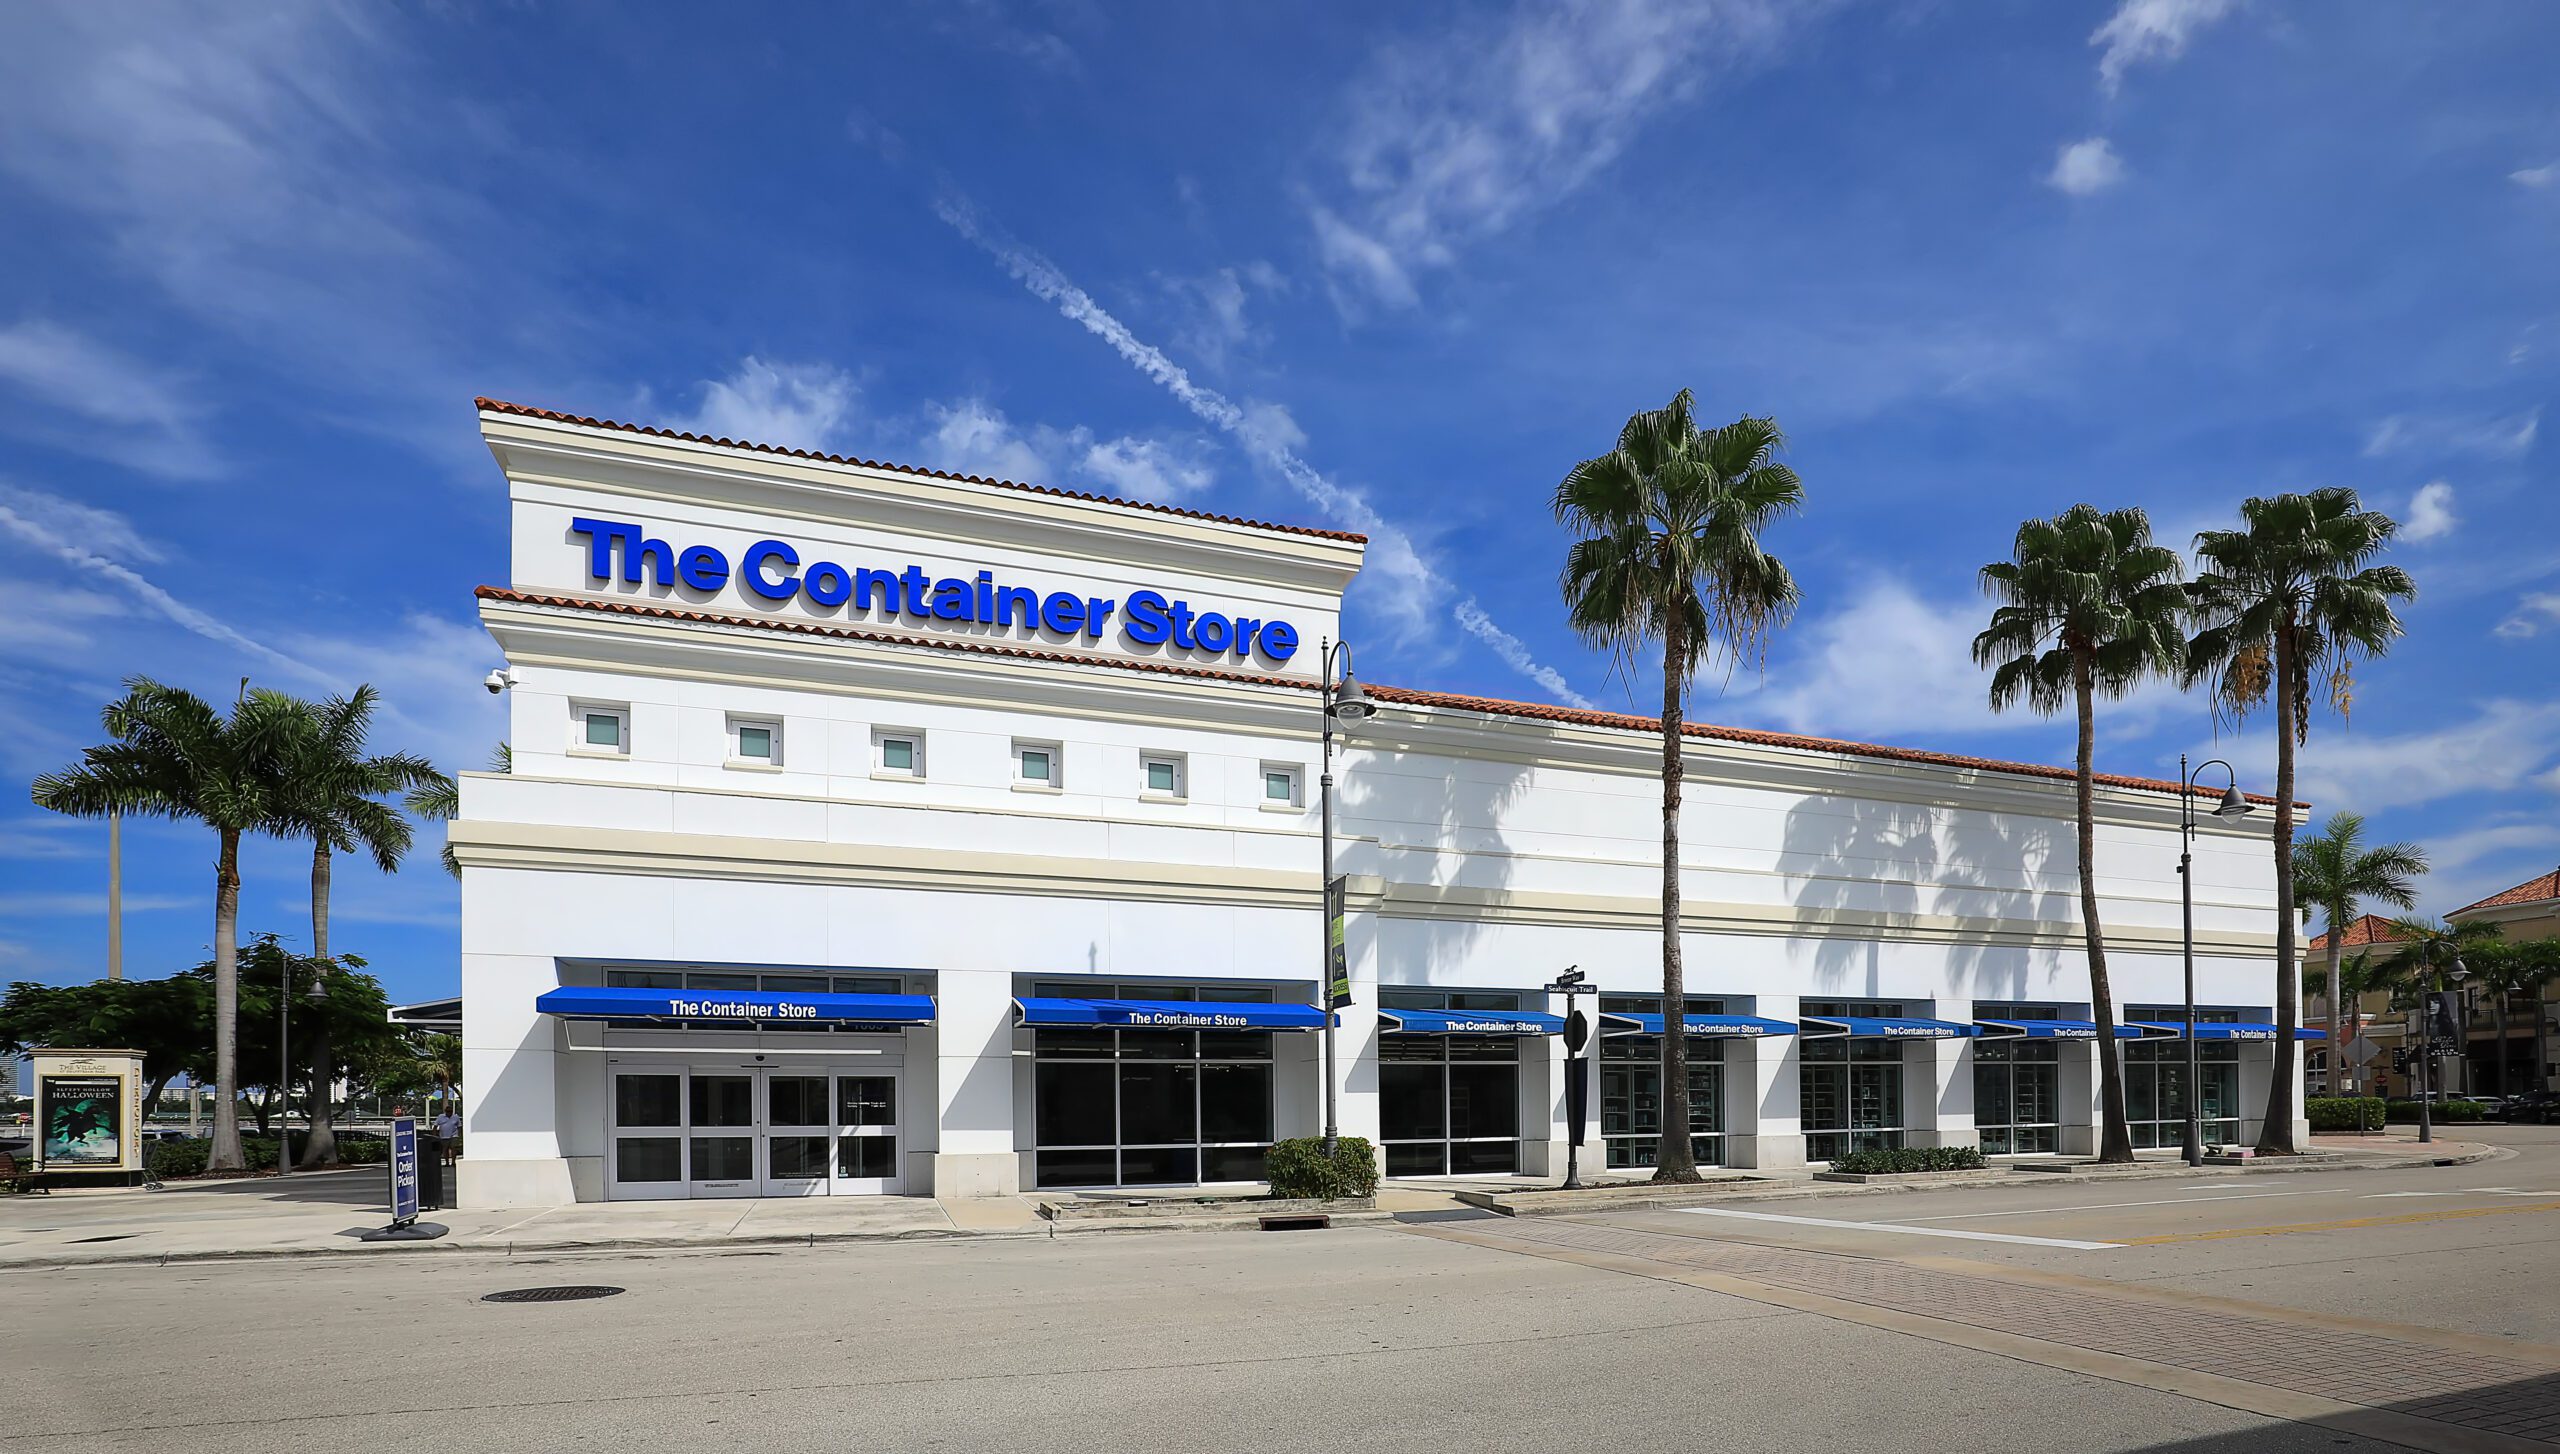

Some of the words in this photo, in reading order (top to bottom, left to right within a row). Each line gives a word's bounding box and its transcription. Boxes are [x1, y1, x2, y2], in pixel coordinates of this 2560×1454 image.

[572, 517, 729, 592] The
[743, 540, 1114, 638] Container
[1125, 590, 1299, 660] Store
[670, 1000, 699, 1016] The
[701, 1001, 773, 1017] Container
[778, 1002, 816, 1018] Store
[1129, 1013, 1151, 1024] The
[1154, 1013, 1212, 1025] Container
[1215, 1014, 1247, 1026] Store
[1446, 1021, 1465, 1031] The
[1466, 1021, 1515, 1031] Container
[1516, 1022, 1542, 1031] Store
[1683, 1023, 1698, 1032] The
[1698, 1023, 1740, 1033] Container
[1741, 1024, 1764, 1033] Store
[1883, 1026, 1899, 1035] The
[1898, 1026, 1934, 1035] Container
[1935, 1027, 1954, 1036] Store
[2053, 1028, 2066, 1036] The
[2066, 1028, 2097, 1037] Container
[2230, 1029, 2239, 1038] The
[2240, 1029, 2267, 1039] Container
[2267, 1030, 2277, 1039] Sto
[399, 1161, 413, 1173] Order
[398, 1175, 414, 1187] Pickup
